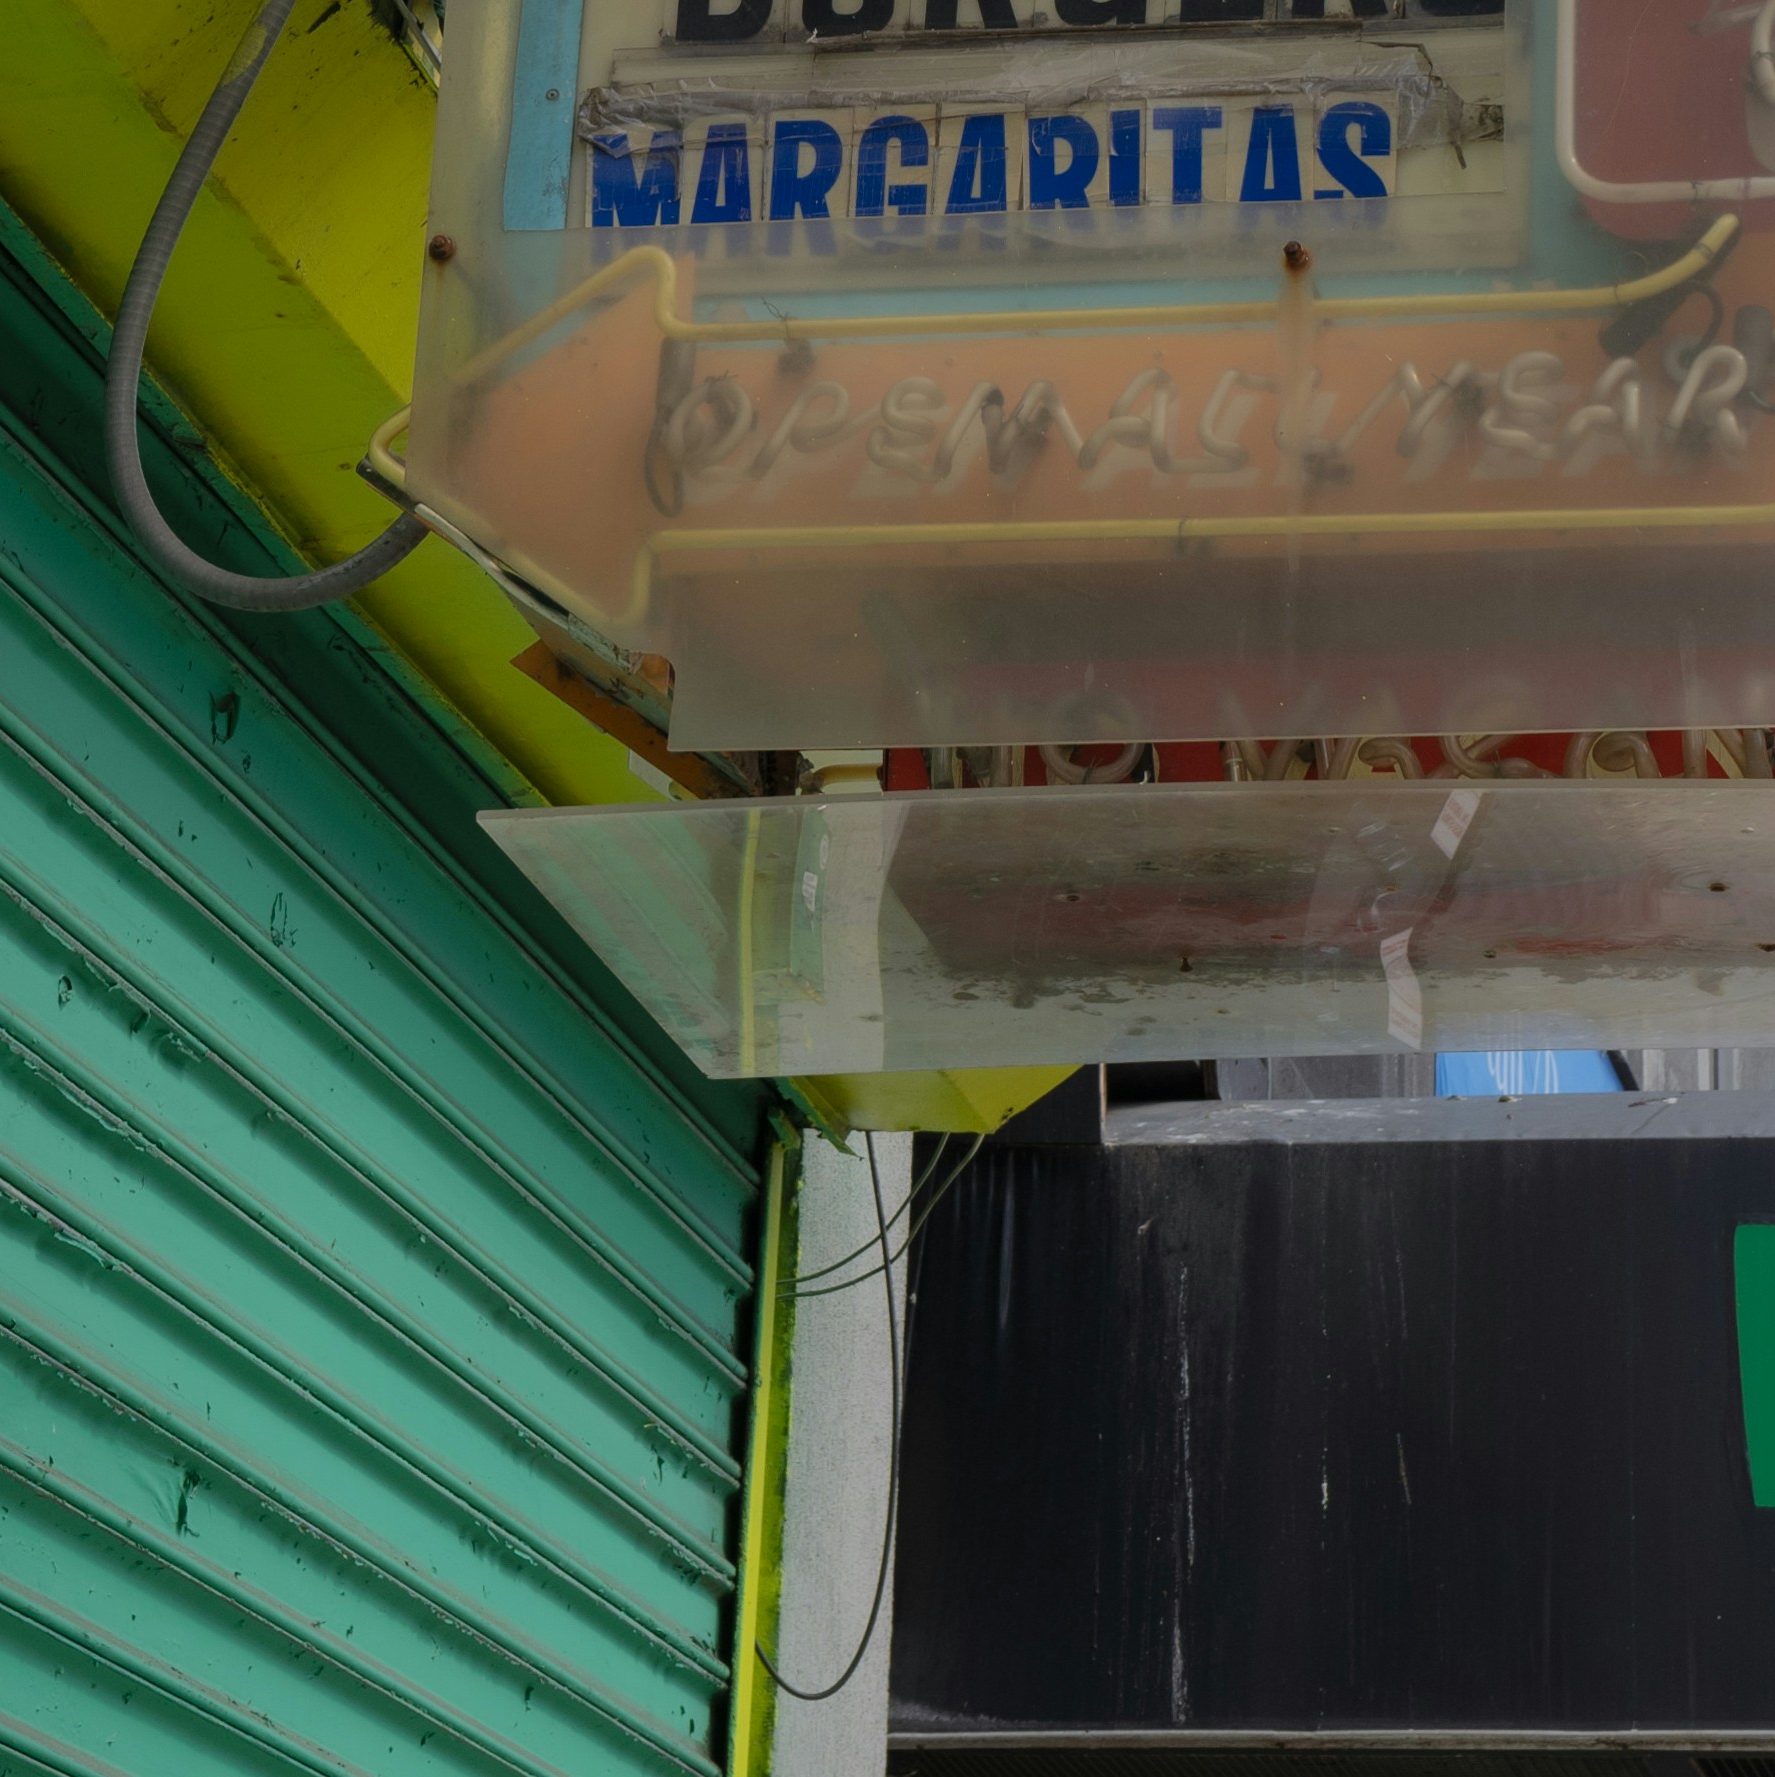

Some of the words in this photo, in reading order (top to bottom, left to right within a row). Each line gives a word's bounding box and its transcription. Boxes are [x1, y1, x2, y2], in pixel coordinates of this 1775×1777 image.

[587, 100, 1395, 254] MARGARITAS
[668, 374, 1057, 502] OPEN
[1393, 344, 1751, 482] YEAR
